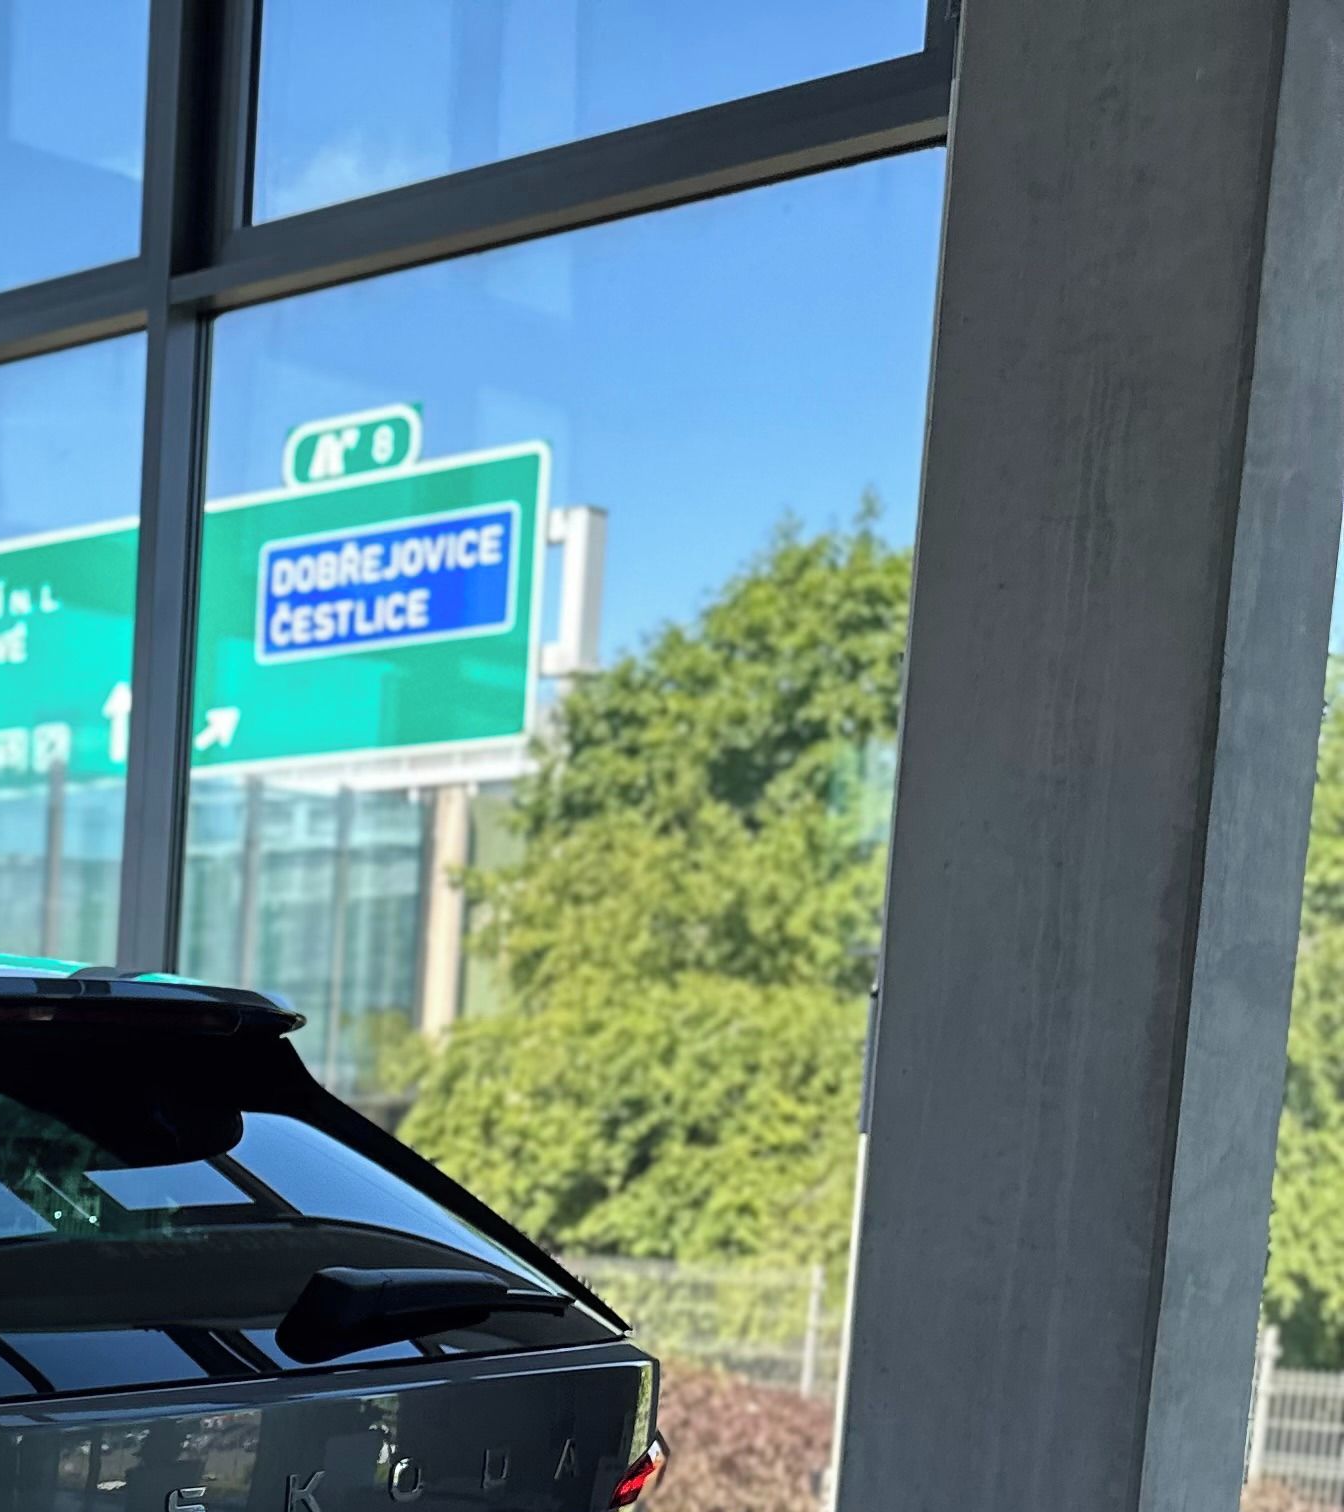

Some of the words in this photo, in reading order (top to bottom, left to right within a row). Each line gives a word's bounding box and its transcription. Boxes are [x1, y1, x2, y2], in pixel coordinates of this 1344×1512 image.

[371, 424, 395, 464] 8
[271, 523, 505, 598] DOBŘEJOVICE
[269, 587, 431, 648] ČESTLICE
